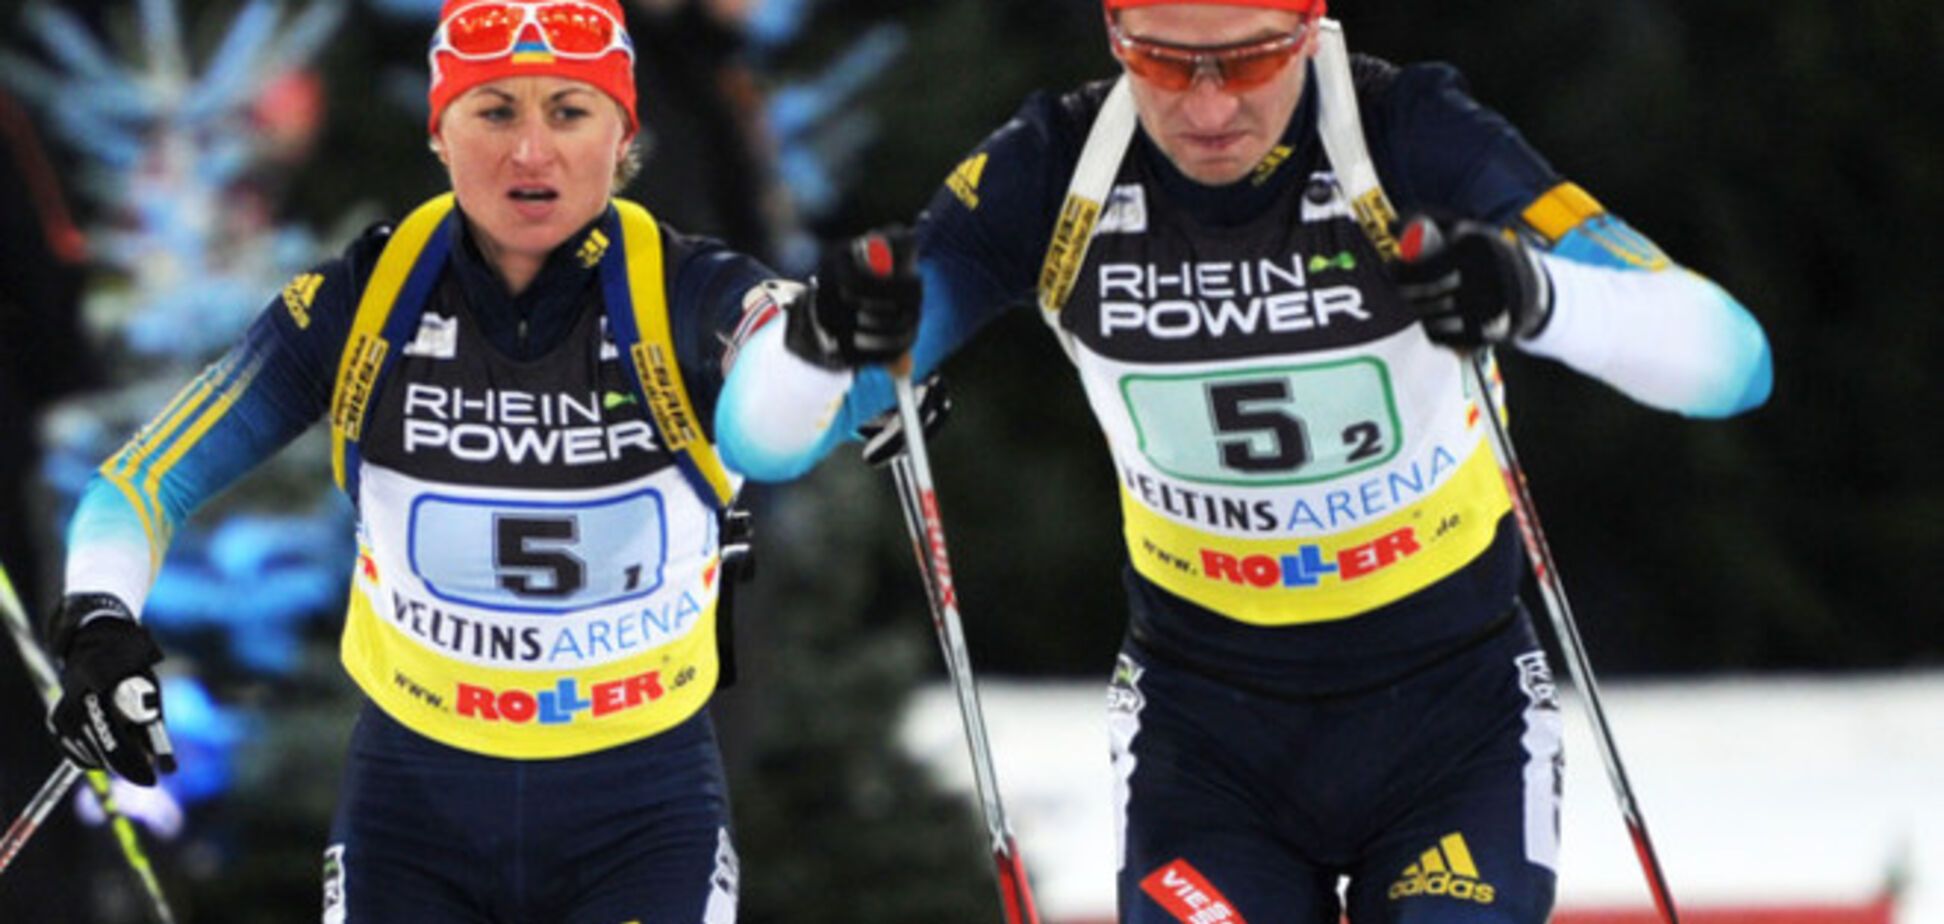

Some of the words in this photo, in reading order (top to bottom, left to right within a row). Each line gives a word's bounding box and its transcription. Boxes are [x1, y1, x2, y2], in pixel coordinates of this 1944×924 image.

[1099, 253, 1307, 299] RHEIN
[1099, 285, 1372, 338] POWER
[405, 382, 601, 426] RHEIN
[1203, 377, 1313, 475] 5
[1341, 420, 1383, 463] 2
[403, 419, 660, 465] POWER
[1286, 445, 1456, 532] ARENA
[491, 511, 588, 602] 5
[623, 563, 644, 592] 1
[1199, 526, 1421, 589] ROLLER
[393, 589, 543, 662] VELTINS
[548, 590, 701, 662] ARENA
[455, 670, 664, 725] ROLLER
[1387, 871, 1496, 905] adidas
